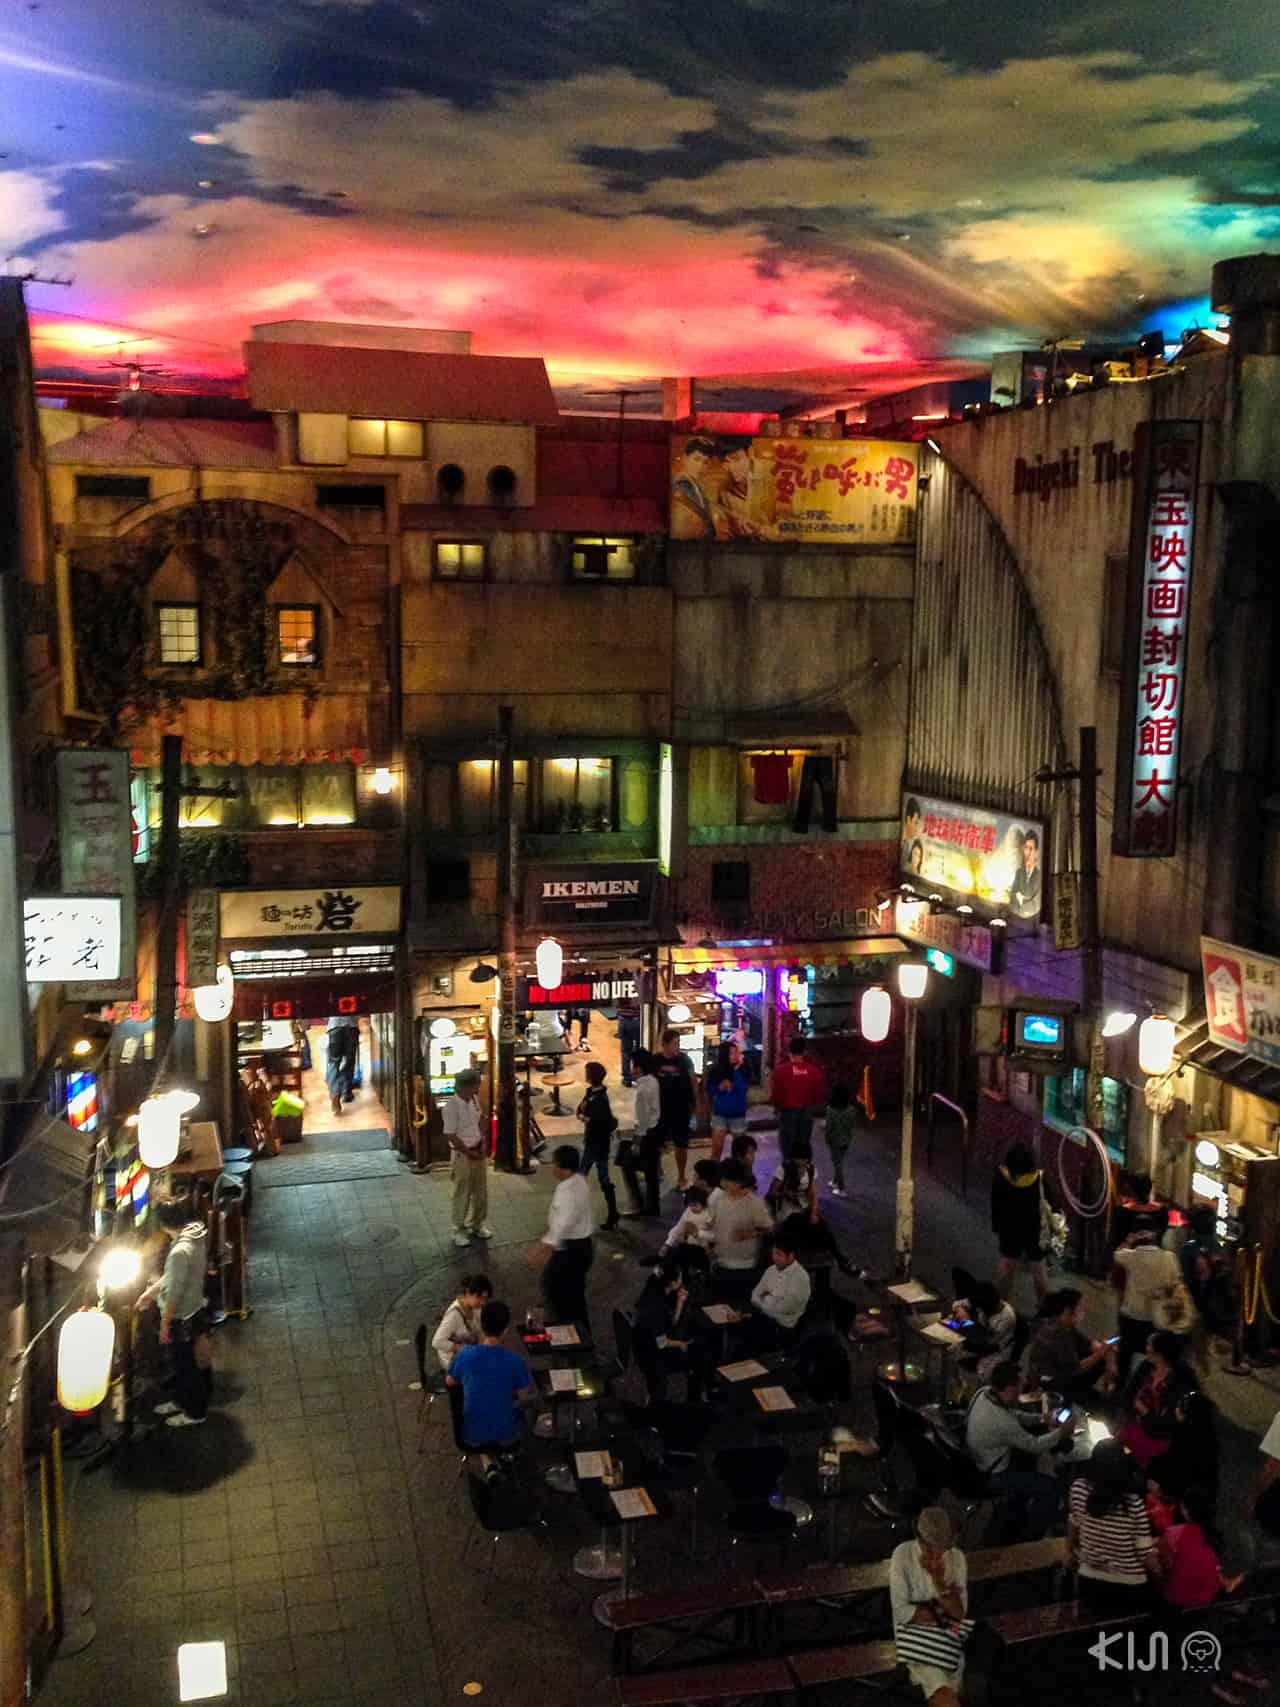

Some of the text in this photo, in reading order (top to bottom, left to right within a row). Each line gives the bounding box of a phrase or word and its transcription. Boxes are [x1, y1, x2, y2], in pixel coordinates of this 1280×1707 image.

[542, 880, 640, 897] IKEMEN
[814, 907, 883, 930] SALON
[592, 982, 611, 1000] NO
